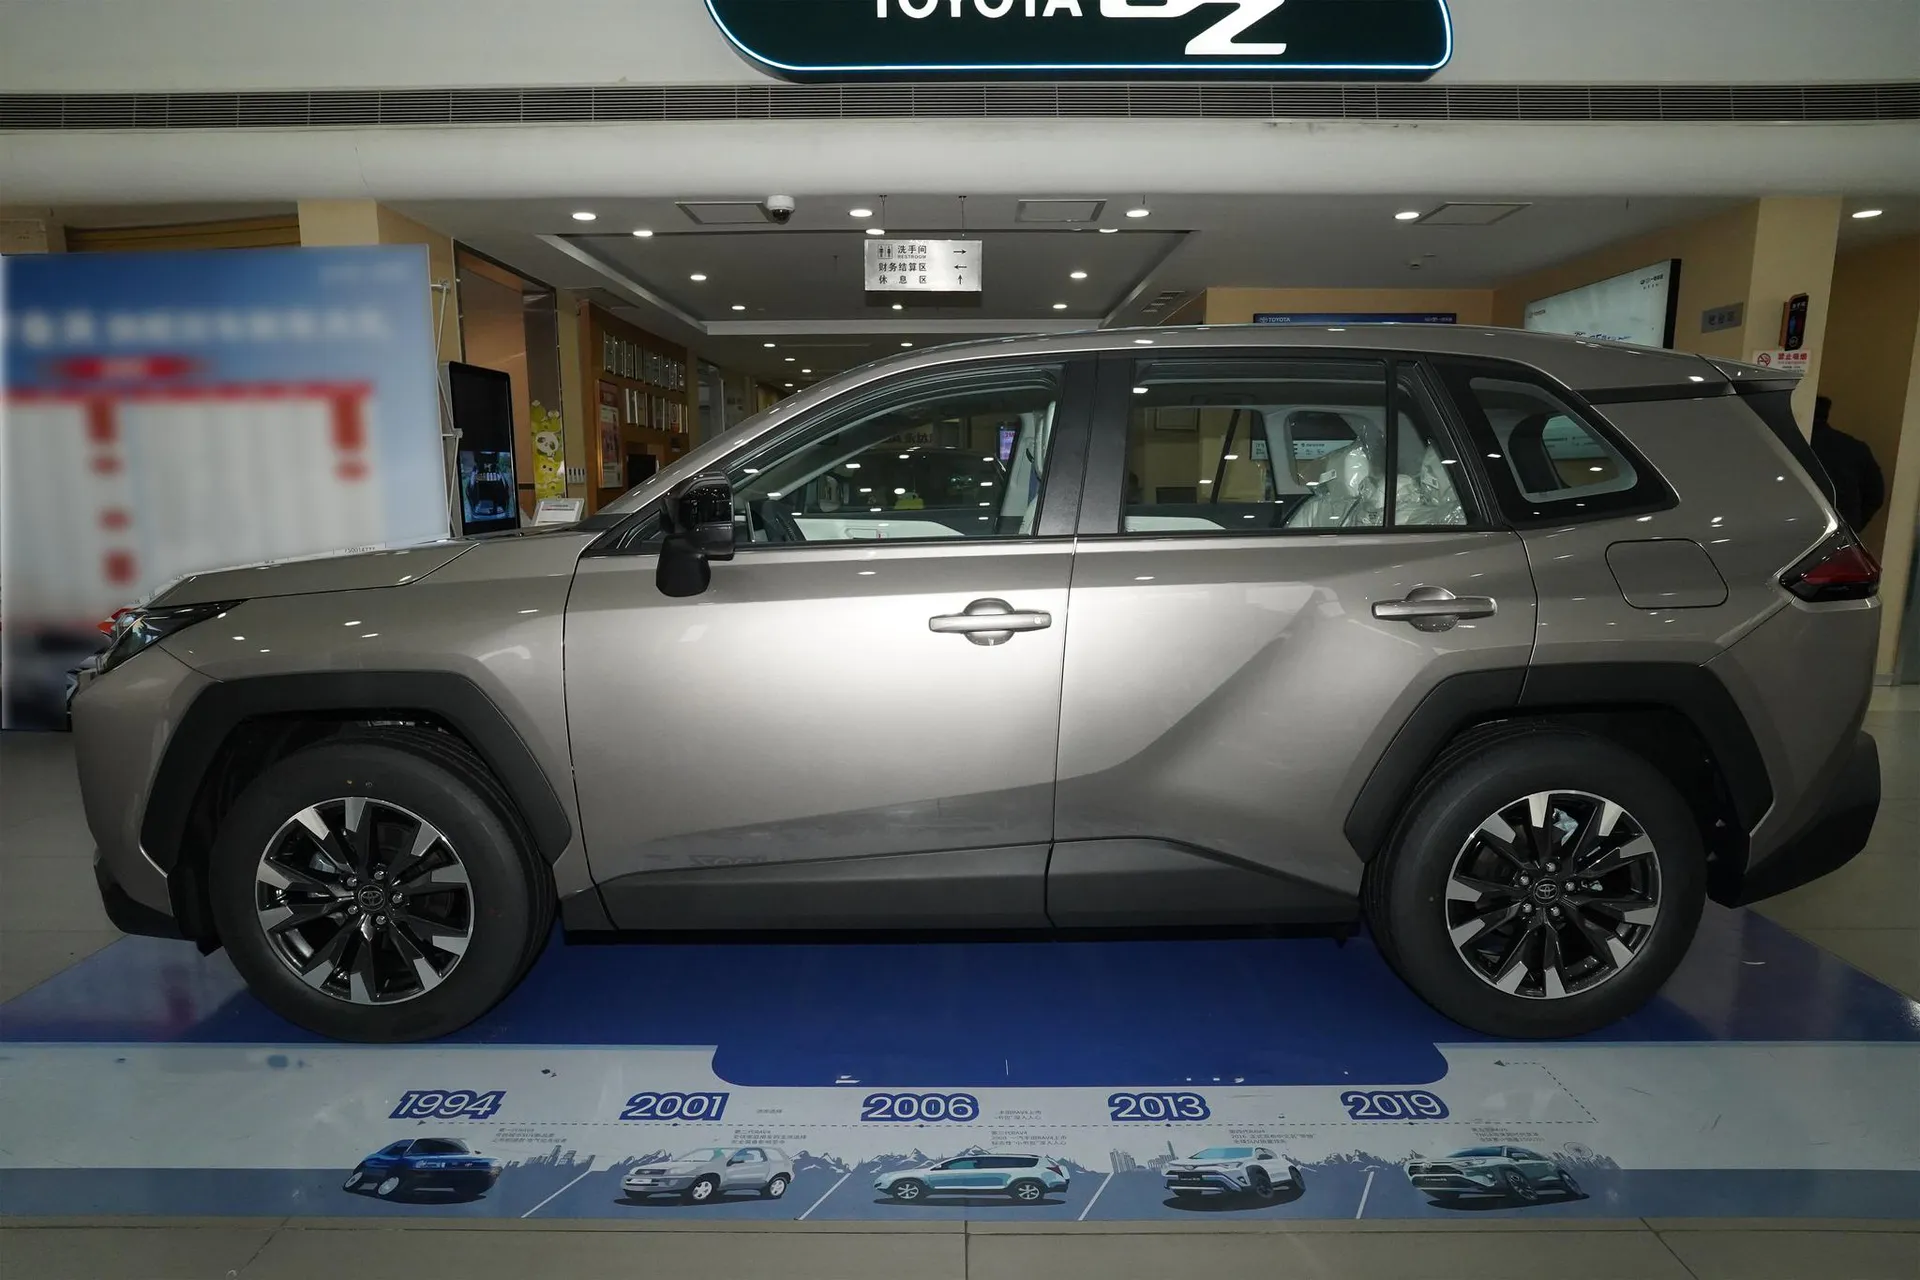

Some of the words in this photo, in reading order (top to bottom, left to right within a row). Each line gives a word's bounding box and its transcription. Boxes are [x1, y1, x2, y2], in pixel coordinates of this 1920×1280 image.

[897, 245, 927, 254] 洗手间
[879, 263, 927, 272] 财务结算区
[1778, 352, 1807, 360] 禁止吸烟
[394, 1092, 500, 1117] 1994
[628, 1094, 726, 1118] 2001
[865, 1095, 975, 1119] 2006
[1110, 1094, 1206, 1119] 2013
[1344, 1092, 1445, 1118] 2019
